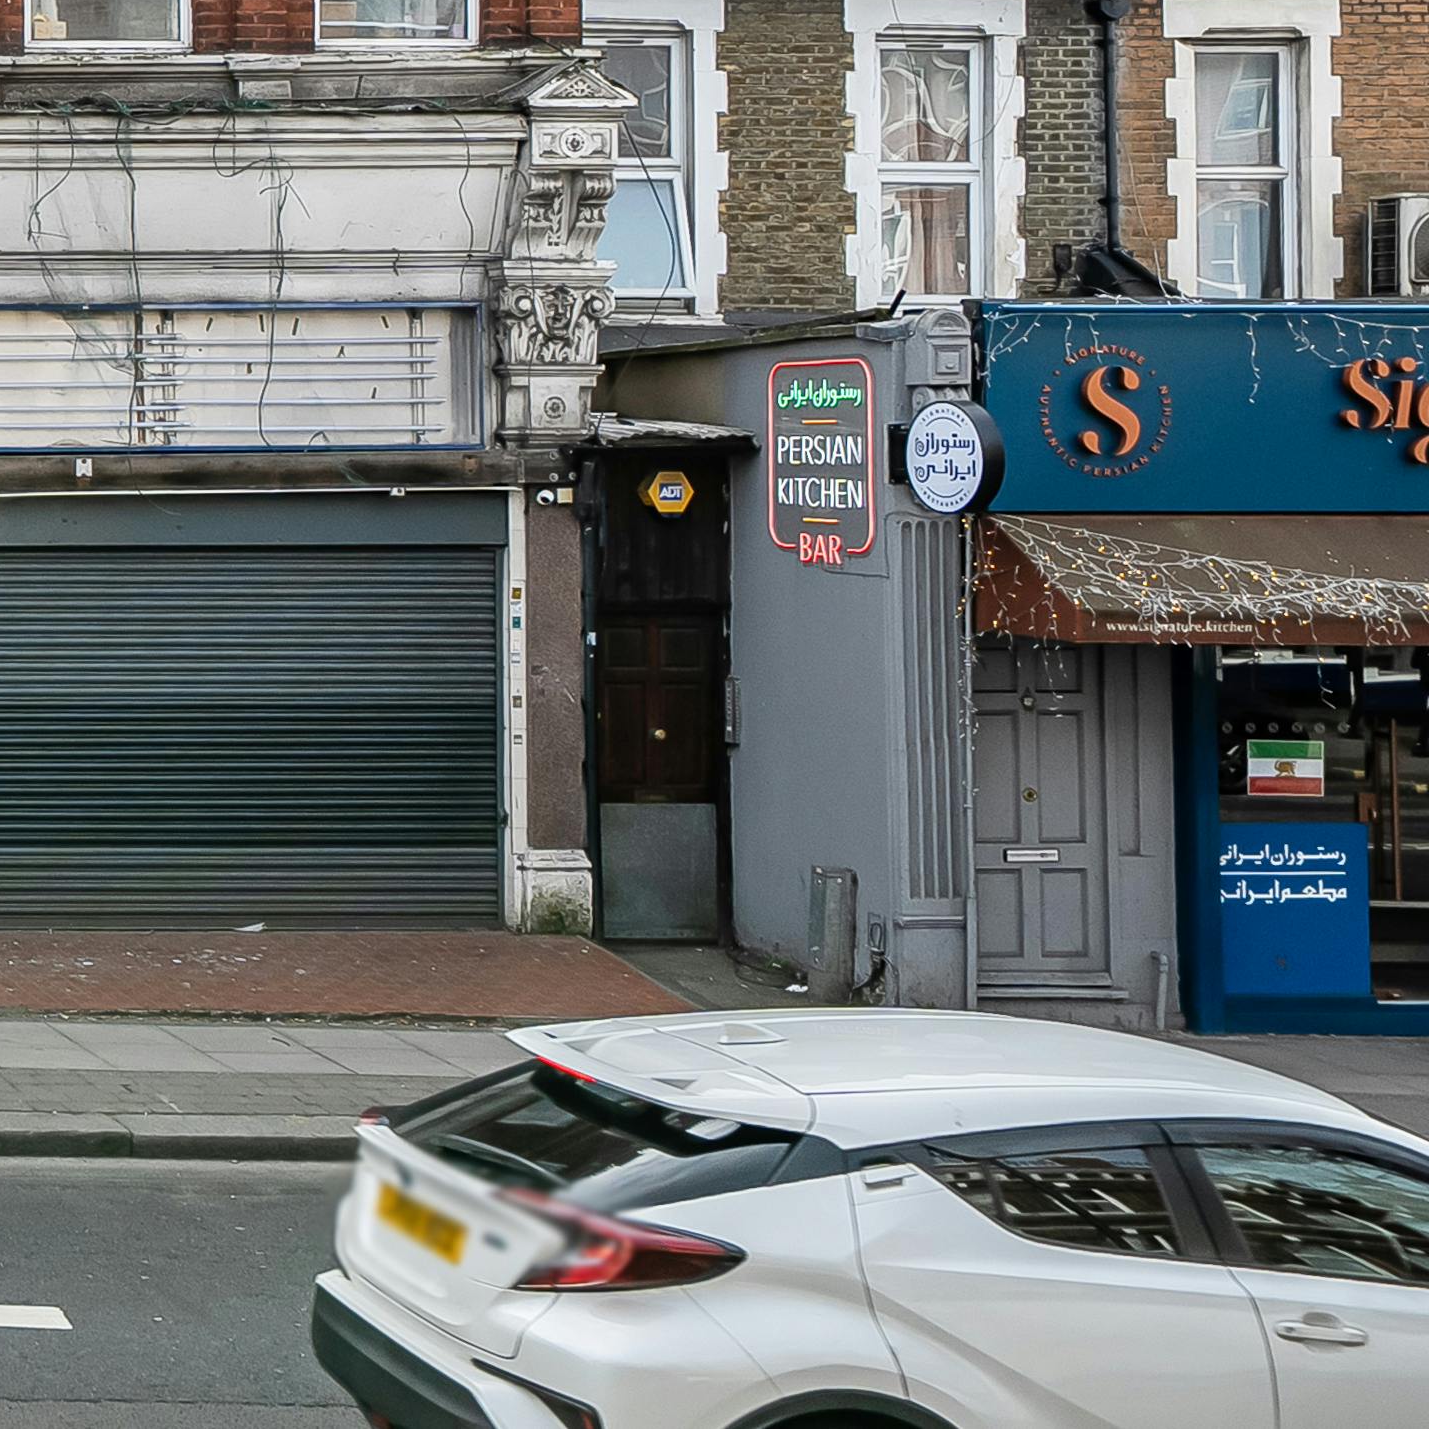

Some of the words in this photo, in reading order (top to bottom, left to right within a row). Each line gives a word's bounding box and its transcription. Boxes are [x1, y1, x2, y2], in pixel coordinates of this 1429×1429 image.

[1339, 356, 1429, 464] Si
[776, 434, 864, 466] PERSIAN
[659, 485, 683, 498] ADT
[776, 476, 866, 510] KITCHEN
[798, 531, 843, 565] BAR
